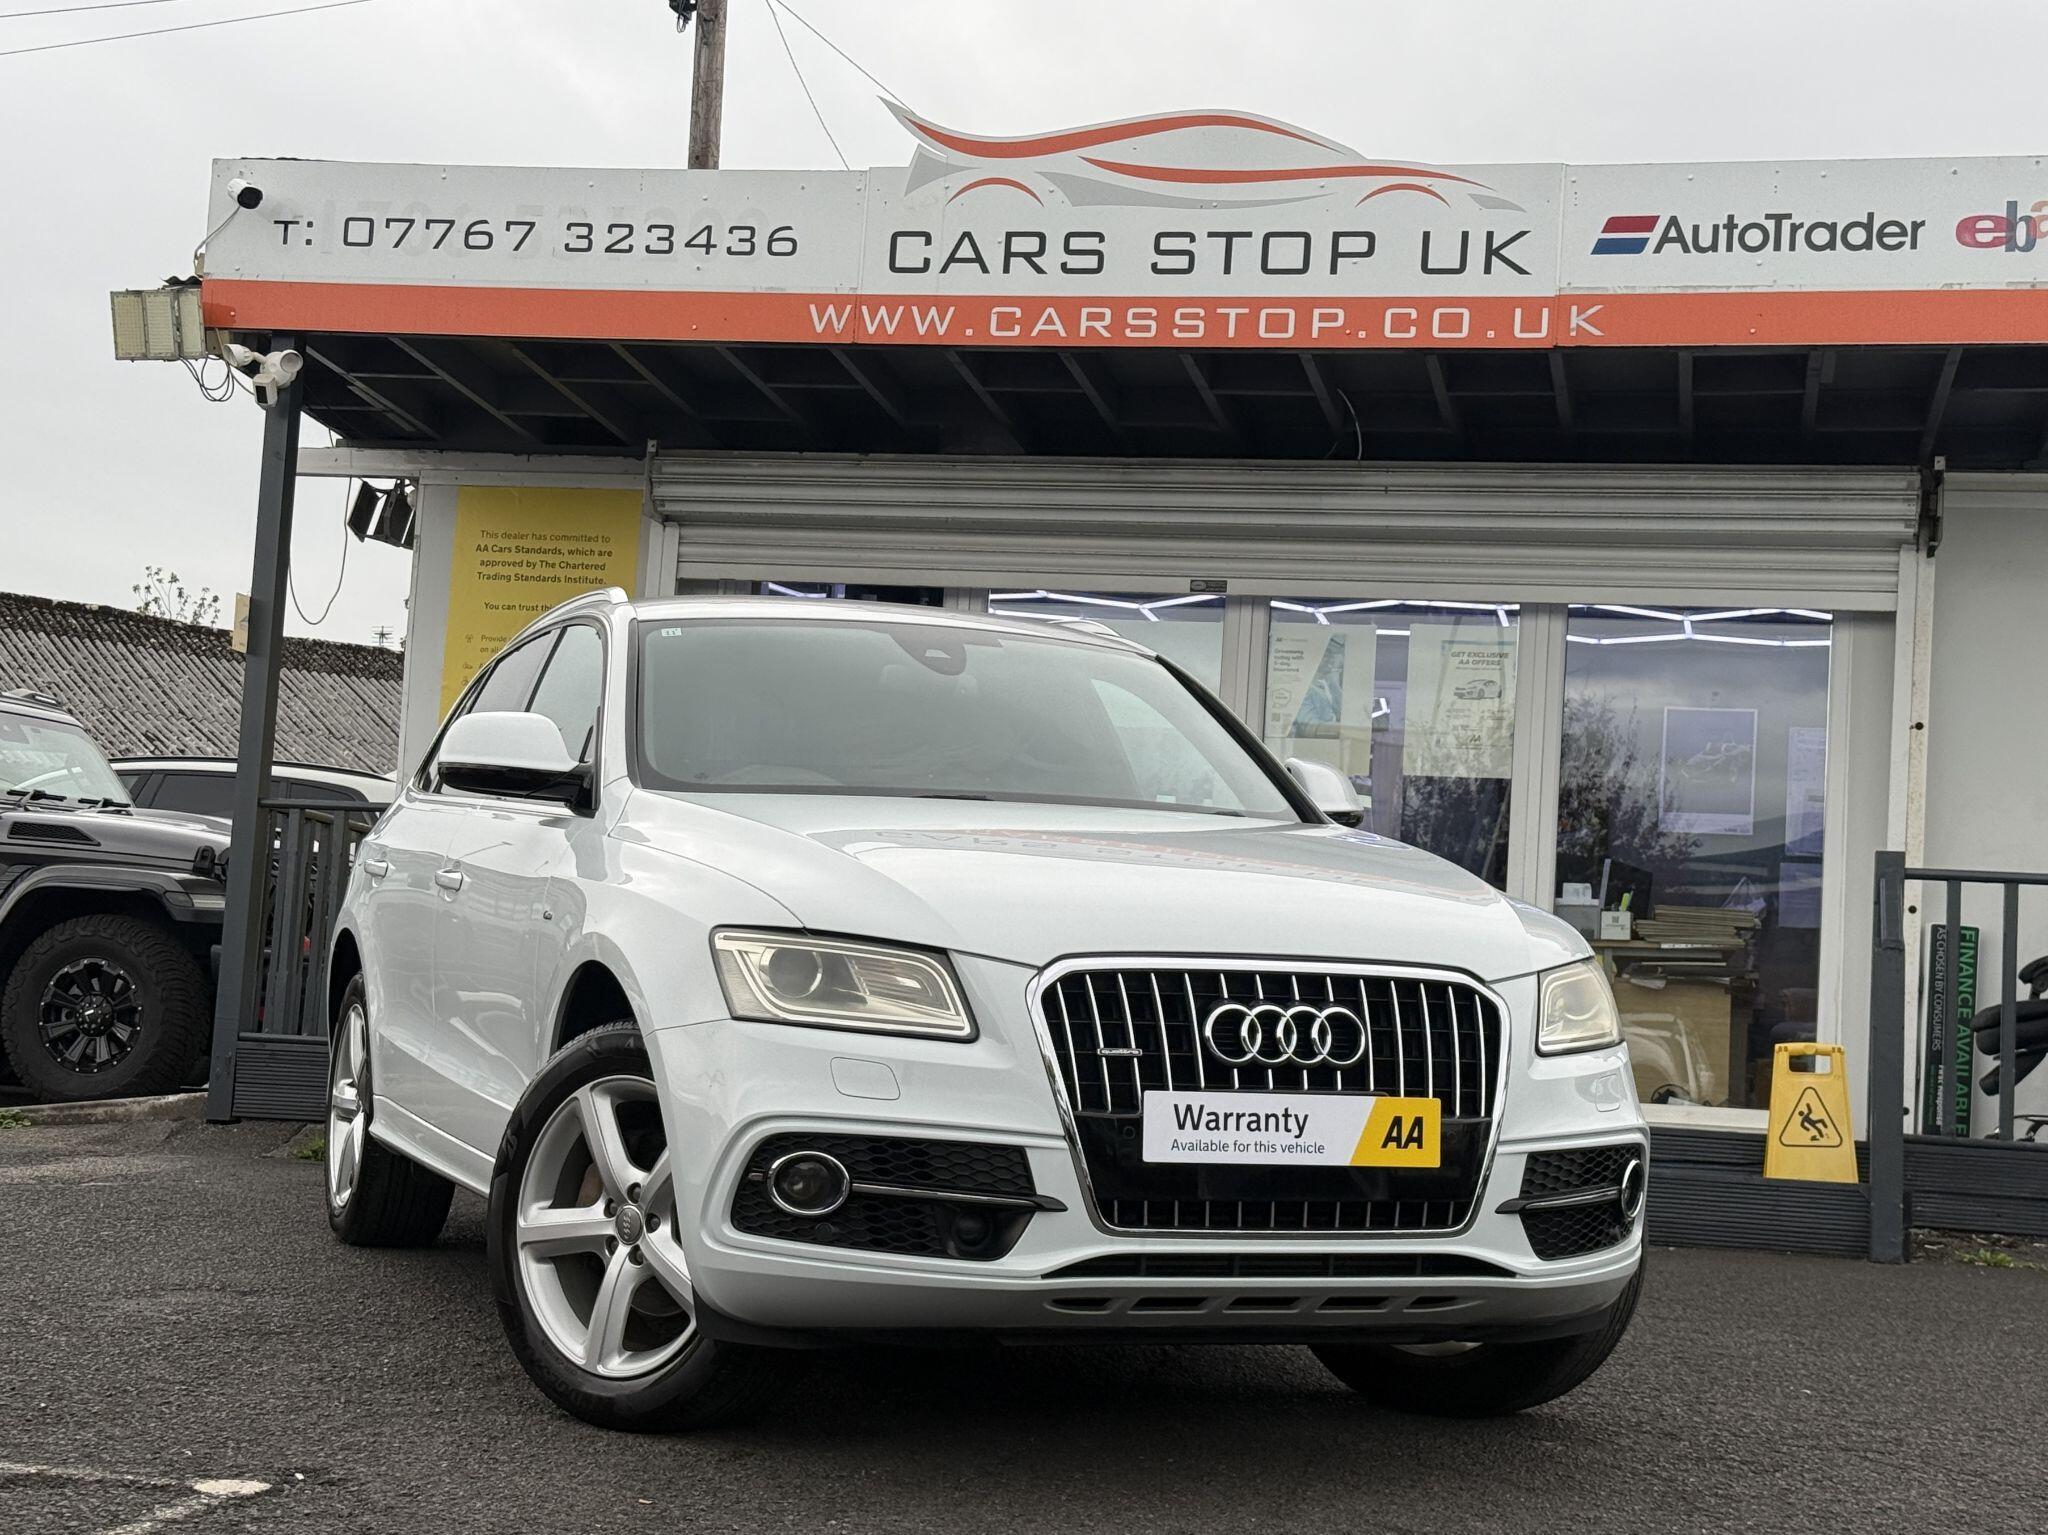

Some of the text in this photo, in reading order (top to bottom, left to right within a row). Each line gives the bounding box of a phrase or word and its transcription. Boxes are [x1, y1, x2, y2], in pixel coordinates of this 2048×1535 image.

[273, 216, 799, 258] T: 07767 323436
[1652, 211, 1926, 255] AutoTrader
[888, 230, 1532, 276] CARS STOP UK
[809, 303, 1605, 339] WWW.CARSSTOP.CO.UK
[480, 530, 611, 544] This dealer has committed to
[475, 544, 613, 558] AA Cars Standards, which are
[479, 558, 606, 571] approved by The Chartered
[477, 571, 607, 585] Trading Standards Institute.
[484, 601, 500, 611] You
[501, 603, 517, 612] can
[518, 602, 539, 612] trust
[481, 634, 507, 643] Provide
[1936, 926, 1946, 941] AS
[1934, 941, 1946, 980] CHOSEN
[1957, 929, 1976, 1019] FINANCE
[1933, 980, 1944, 993] BY
[1931, 993, 1944, 1051] CONSUMERS
[1173, 1103, 1424, 1150] Warranty AA
[1170, 1138, 1326, 1155] Available for this vehicle
